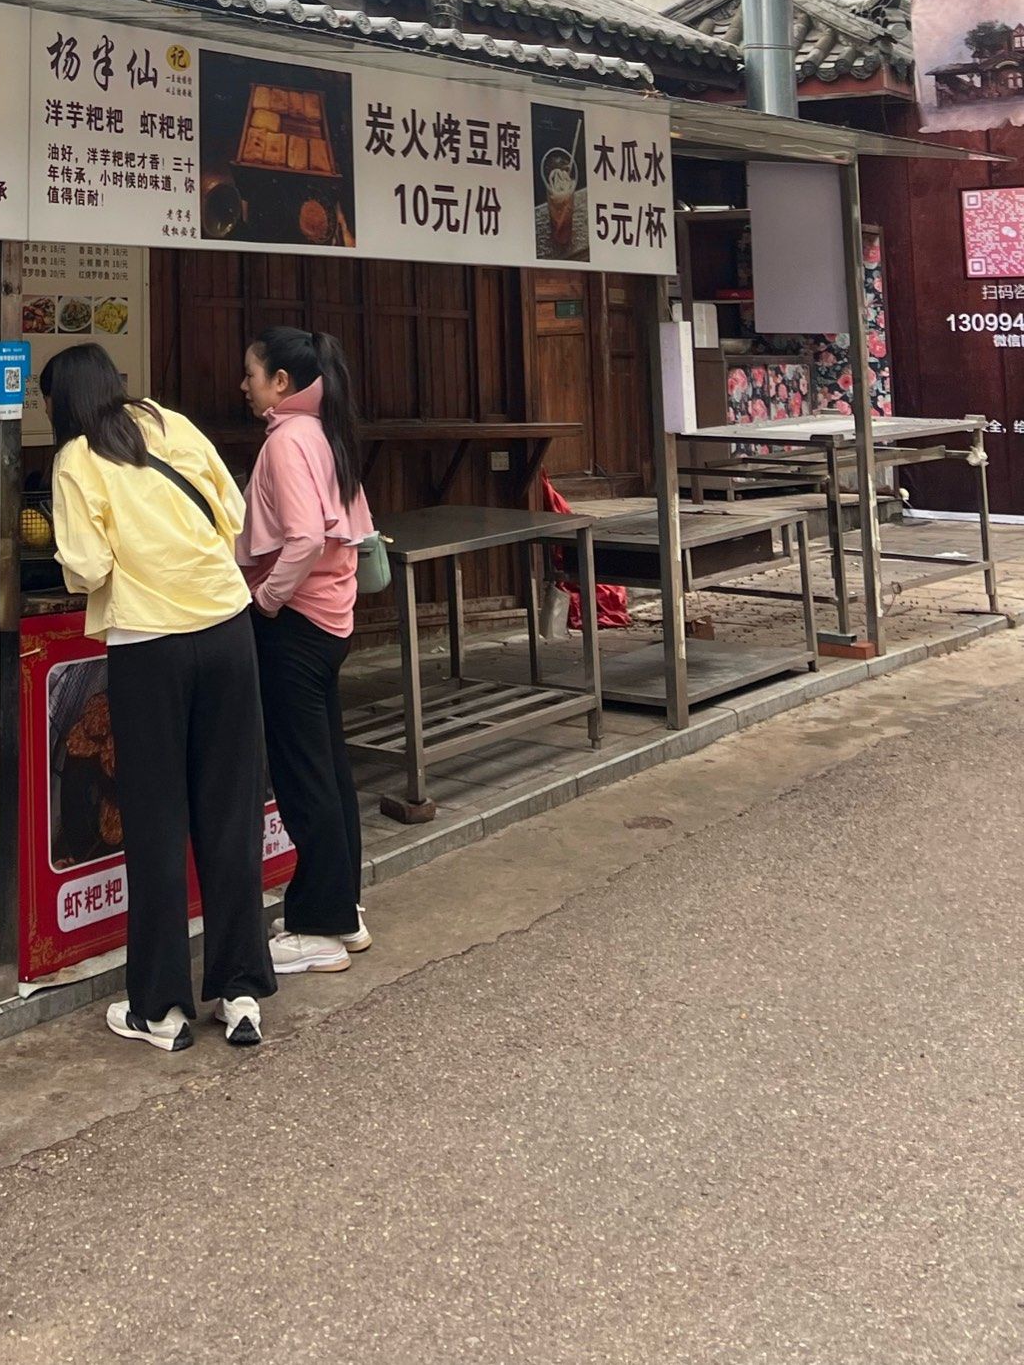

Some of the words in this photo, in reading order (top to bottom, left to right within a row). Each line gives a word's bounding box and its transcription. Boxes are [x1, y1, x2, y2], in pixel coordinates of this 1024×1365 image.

[46, 31, 158, 92] 杨半仙
[170, 46, 187, 68] 记
[45, 99, 124, 134] 洋芋粑粑
[139, 111, 194, 141] 虾粑粑
[365, 103, 521, 171] 炭火烤豆腐
[47, 143, 194, 173] 油好，洋芋粑粑才香！三十
[47, 164, 195, 193] 年传承，小时候的味道，你
[593, 135, 666, 187] 木瓜水
[47, 186, 105, 207] 值得信耐！
[394, 184, 501, 236] 10元/份
[595, 202, 667, 248] 5元/杯
[62, 878, 124, 919] 虾粑粑
